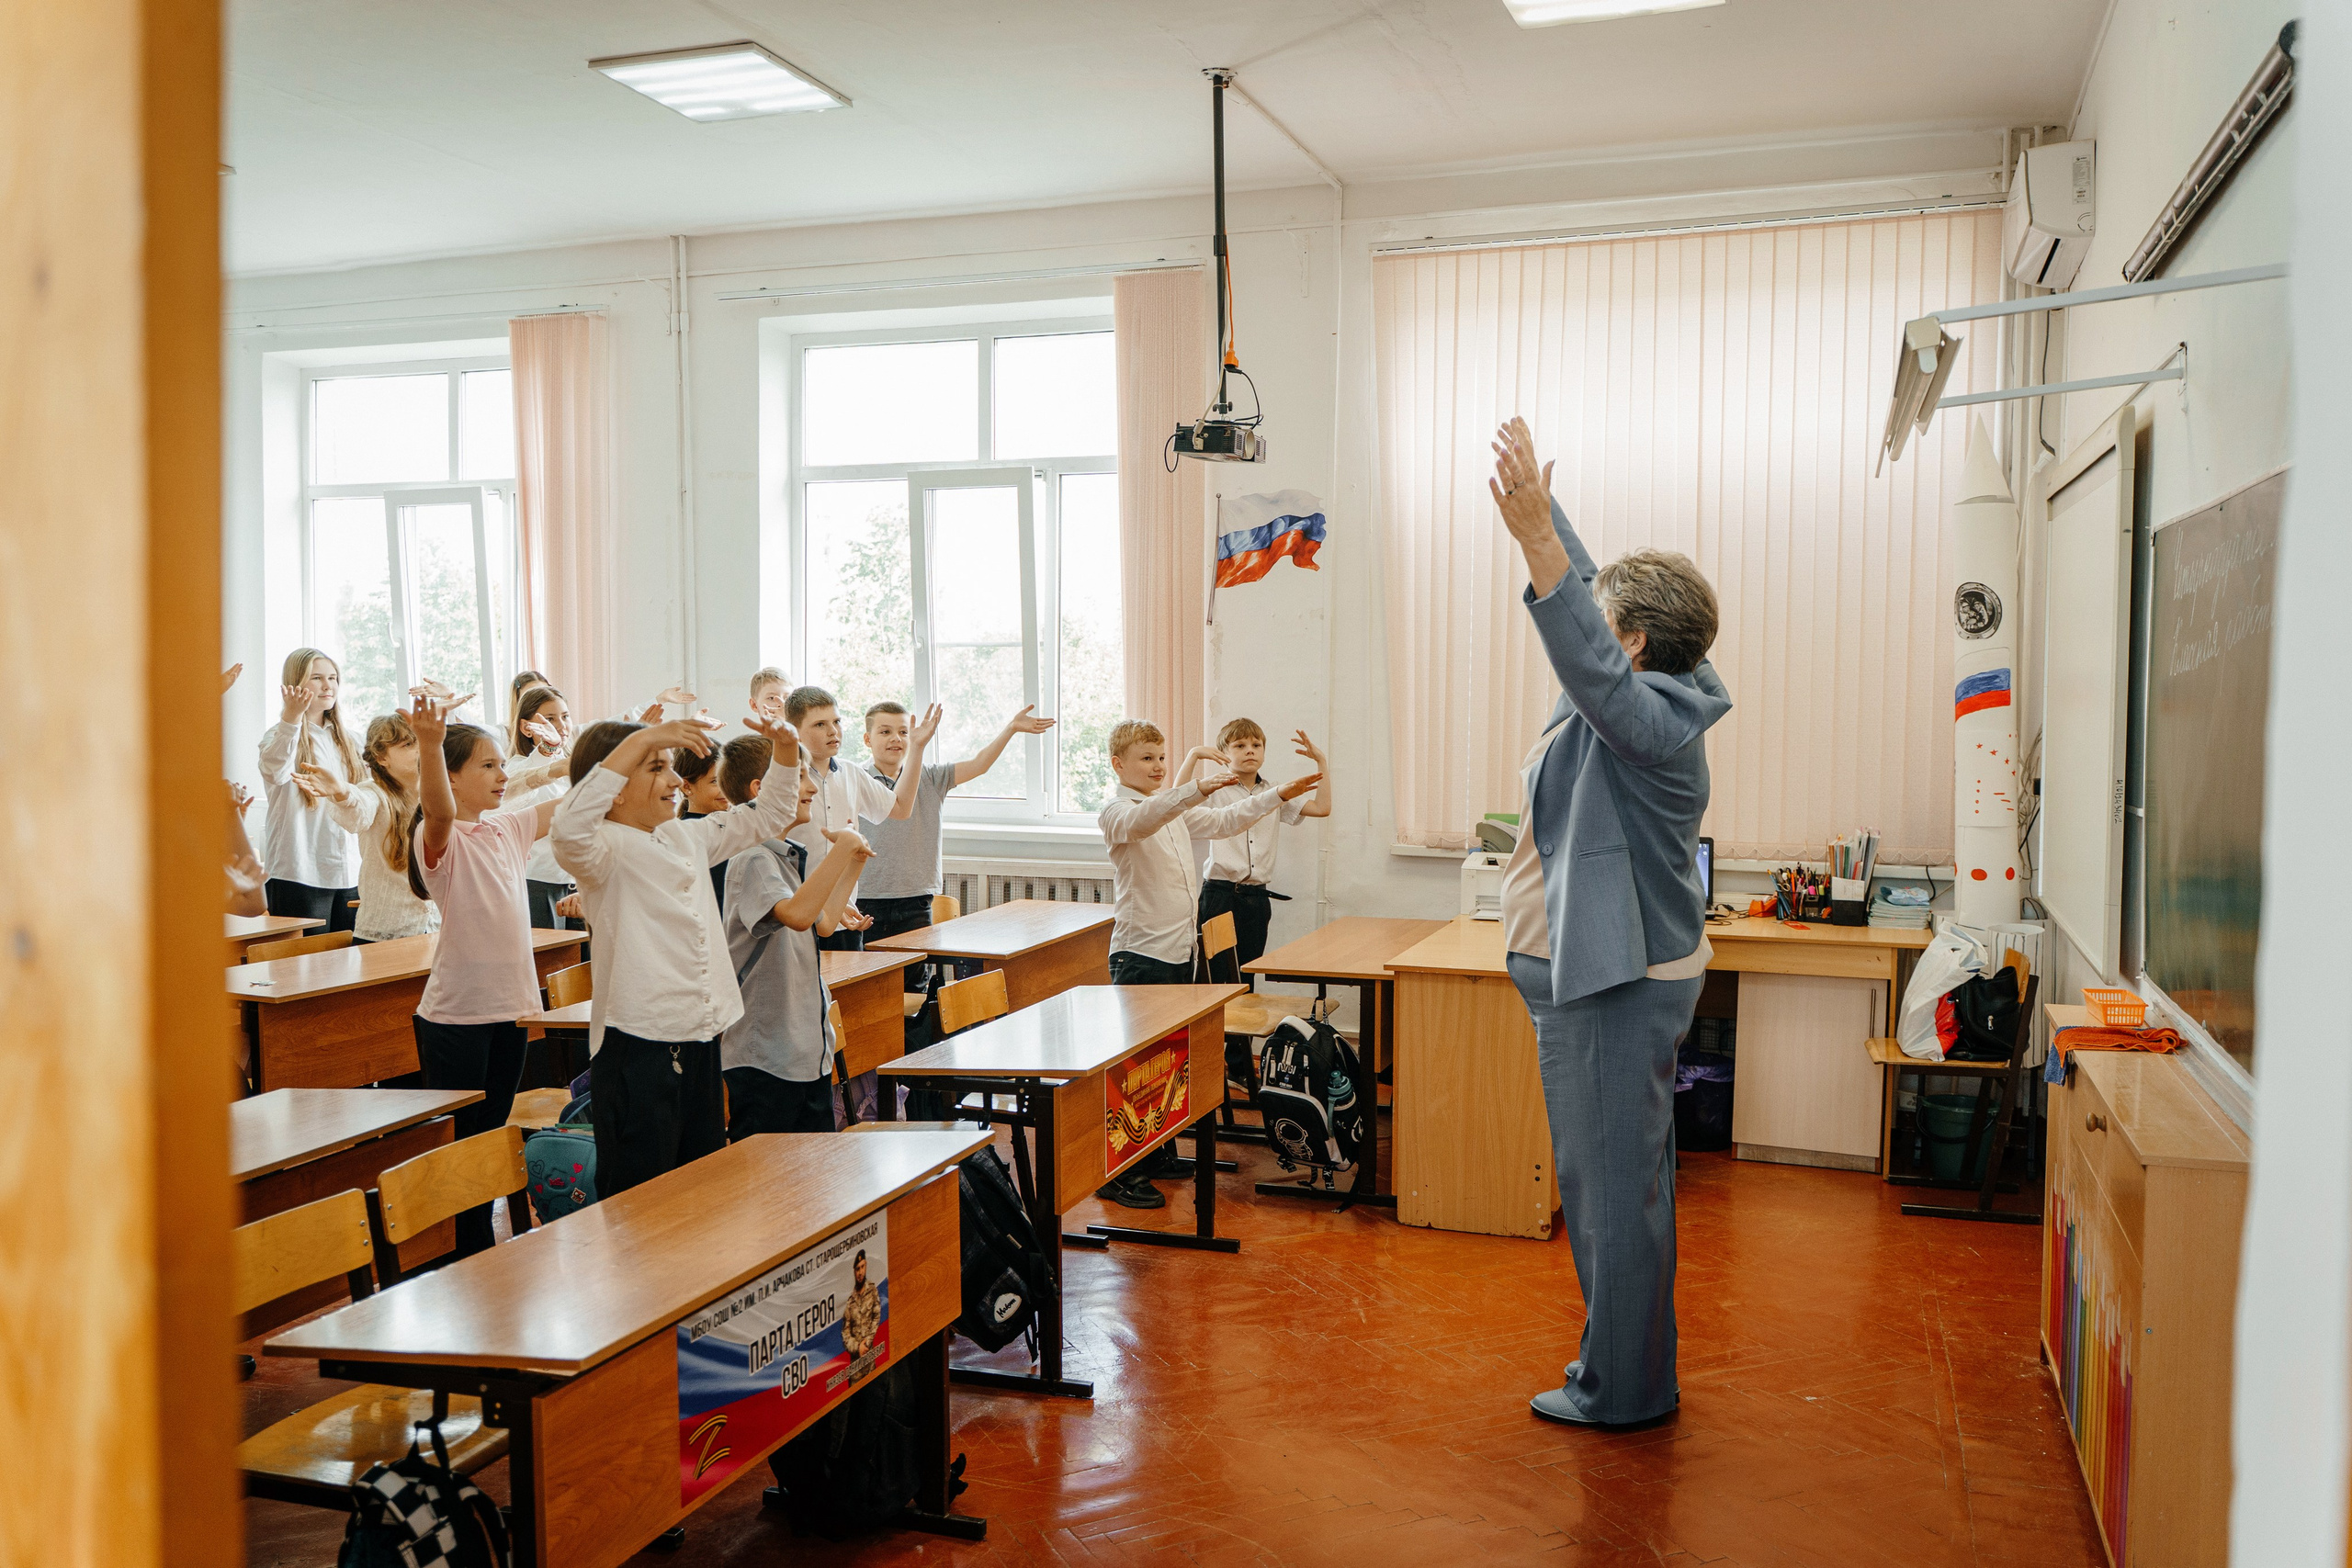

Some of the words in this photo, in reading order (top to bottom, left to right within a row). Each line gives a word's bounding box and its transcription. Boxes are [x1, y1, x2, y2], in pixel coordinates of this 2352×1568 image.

[691, 1314, 712, 1341] МБОУ
[714, 1306, 729, 1327] СОШ
[731, 1299, 742, 1318] №2
[773, 1264, 805, 1293] АРЧАКОВА
[816, 1222, 878, 1269] СТАРОЩЕРБИНОВСКАЯ
[750, 1320, 794, 1374] ПАРТА
[797, 1293, 835, 1344] ГЕРОЯ
[782, 1355, 808, 1397] СВО
[688, 1414, 731, 1480] Z
